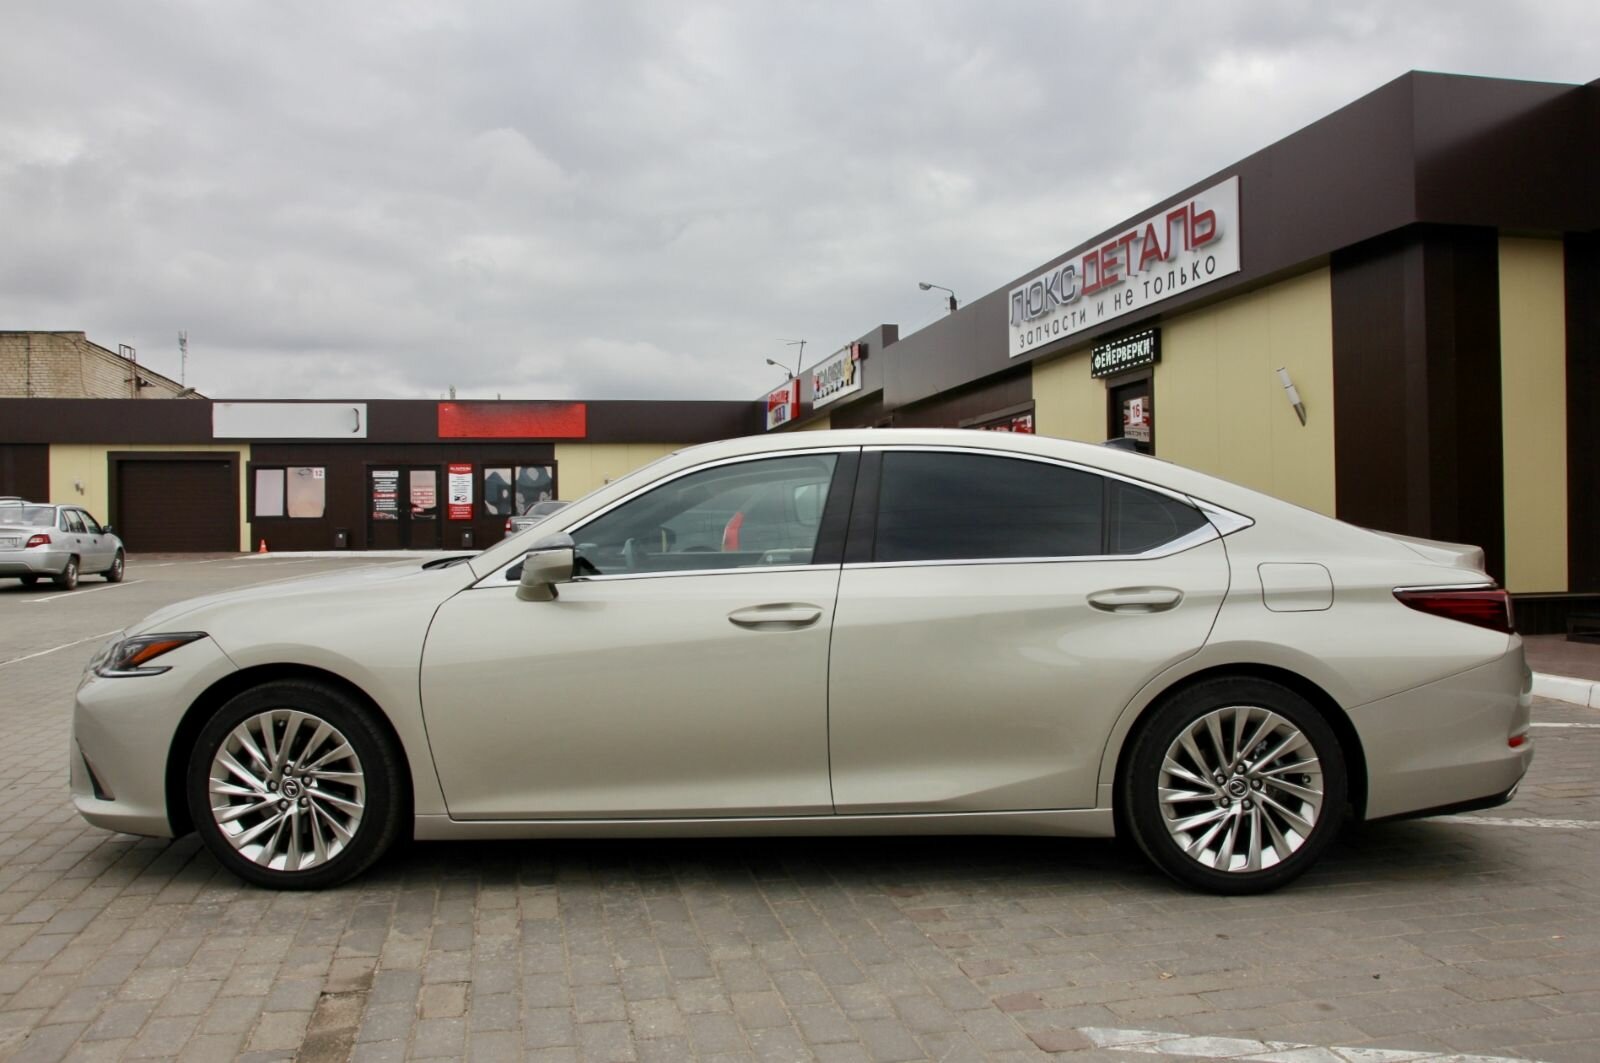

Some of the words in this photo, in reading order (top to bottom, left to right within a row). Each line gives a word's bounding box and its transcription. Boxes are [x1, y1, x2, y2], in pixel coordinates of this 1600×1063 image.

[1011, 264, 1078, 326] ЛЮКС
[1081, 201, 1217, 296] ДЕТАЛЬ
[1019, 308, 1087, 349] запчасти
[1097, 301, 1104, 317] и
[1143, 255, 1216, 299] только
[1094, 337, 1151, 369] ФЕЙЕРВЕРКИ
[1132, 403, 1141, 419] 16
